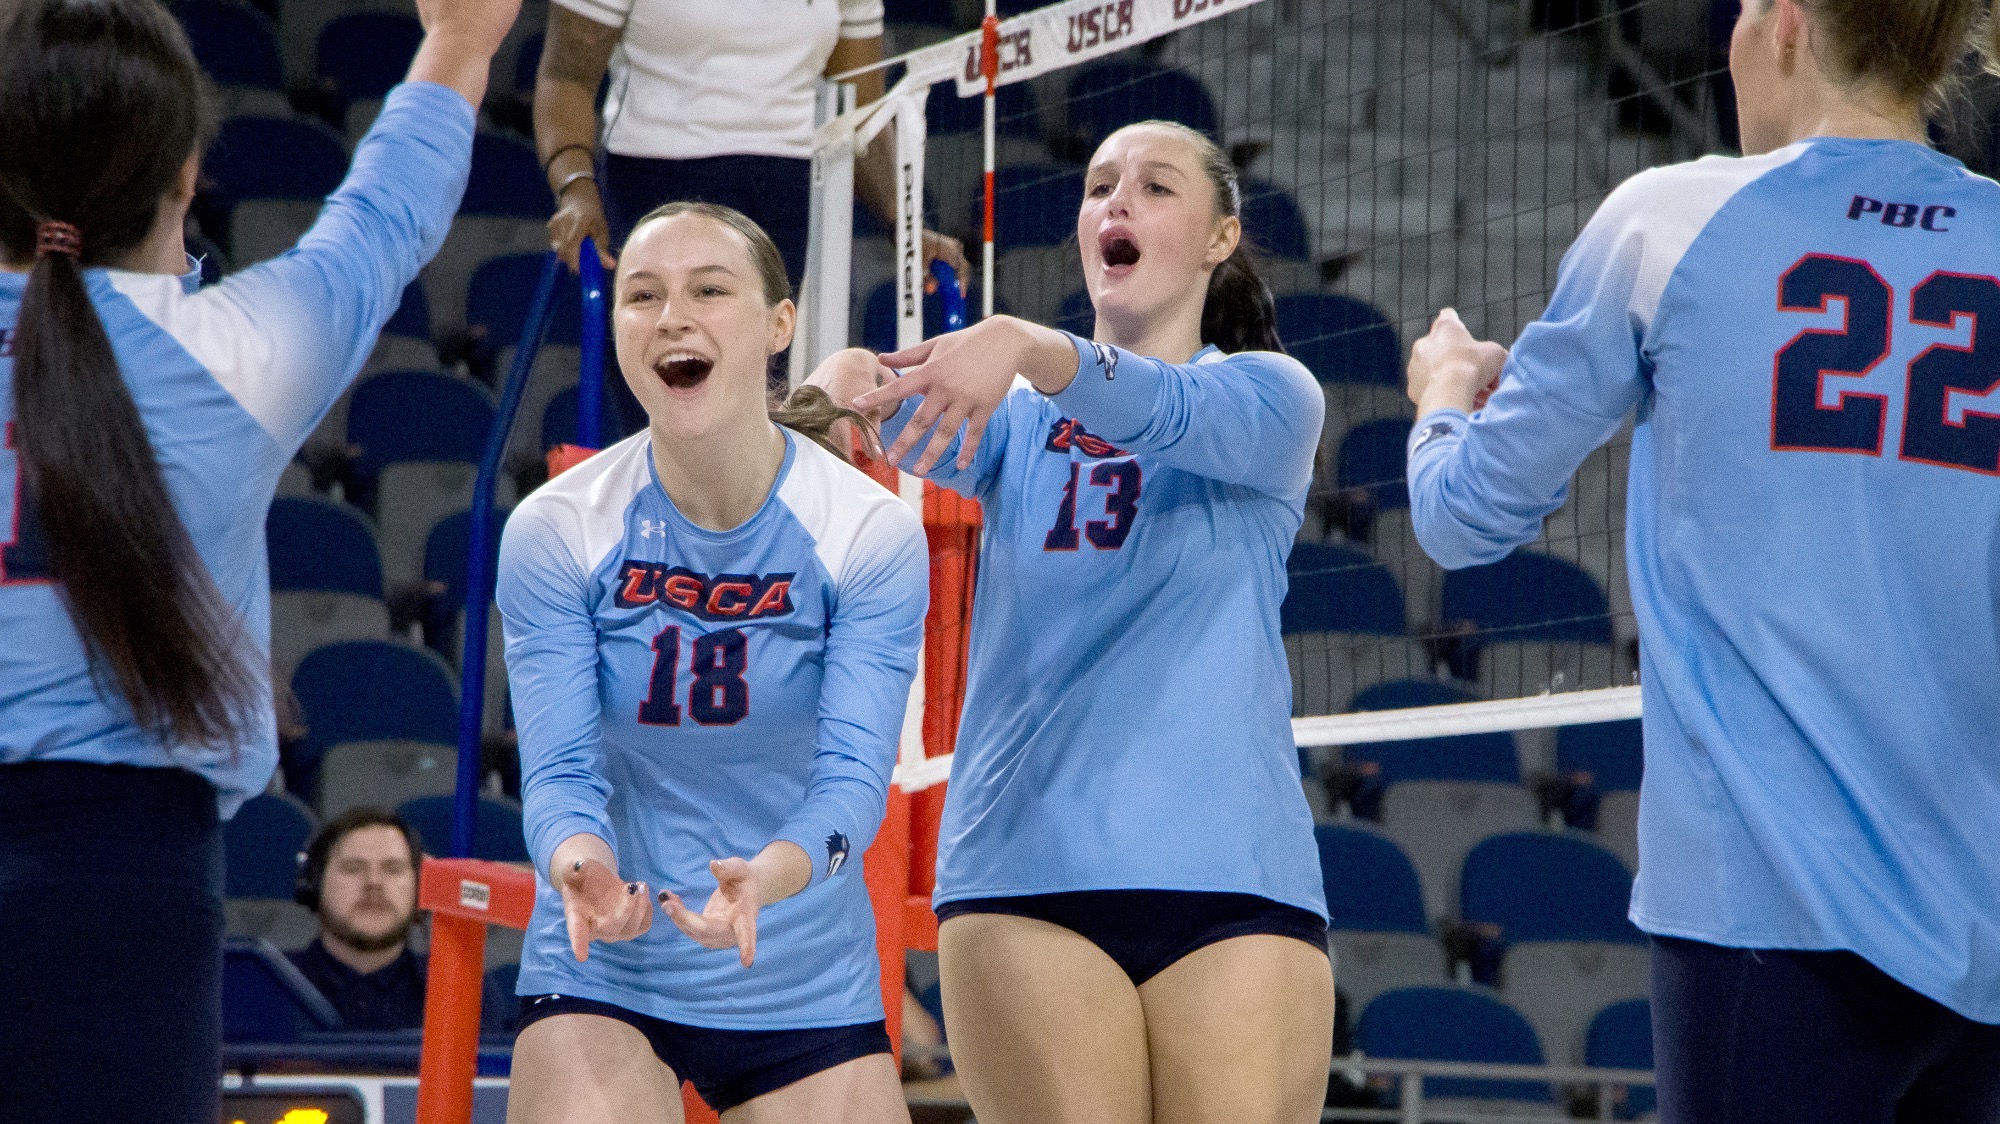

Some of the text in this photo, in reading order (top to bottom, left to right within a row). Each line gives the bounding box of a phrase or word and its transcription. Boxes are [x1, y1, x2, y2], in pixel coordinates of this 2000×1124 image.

[965, 29, 1032, 82] UCA
[1066, 0, 1133, 53] USCA
[1847, 194, 1957, 233] PBC
[1770, 252, 2000, 477] 22
[1043, 458, 1142, 551] 13
[616, 561, 795, 621] USCA
[637, 624, 749, 728] 18
